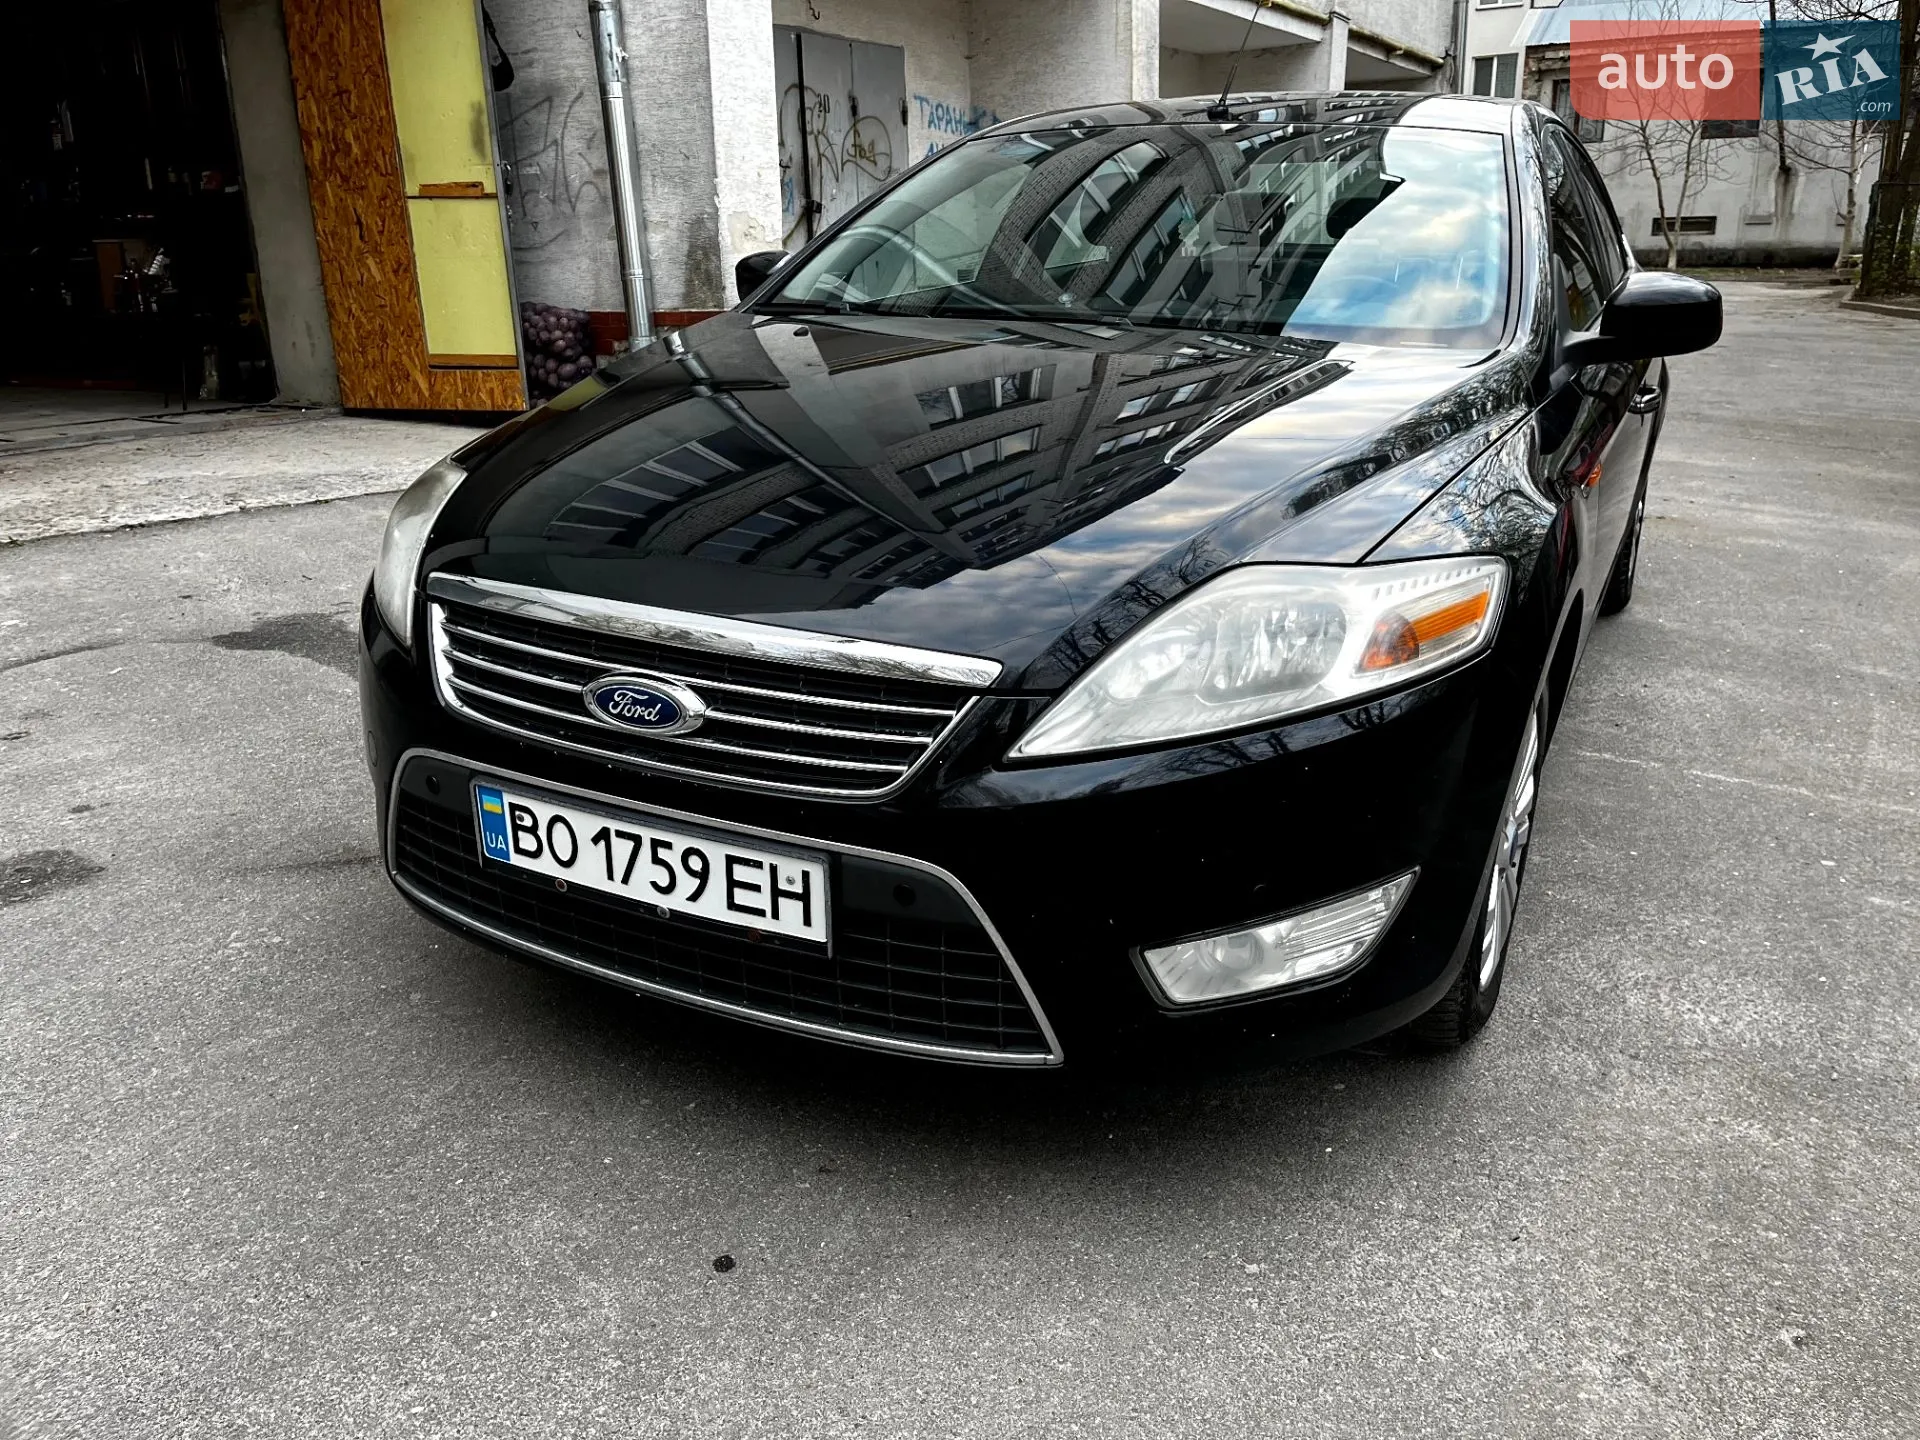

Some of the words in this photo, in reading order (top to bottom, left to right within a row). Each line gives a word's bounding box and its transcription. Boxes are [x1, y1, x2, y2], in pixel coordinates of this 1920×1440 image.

[609, 690, 661, 721] Ford
[487, 832, 507, 851] UA
[508, 802, 578, 868] BO
[591, 826, 710, 902] 1759
[725, 854, 812, 927] EH
